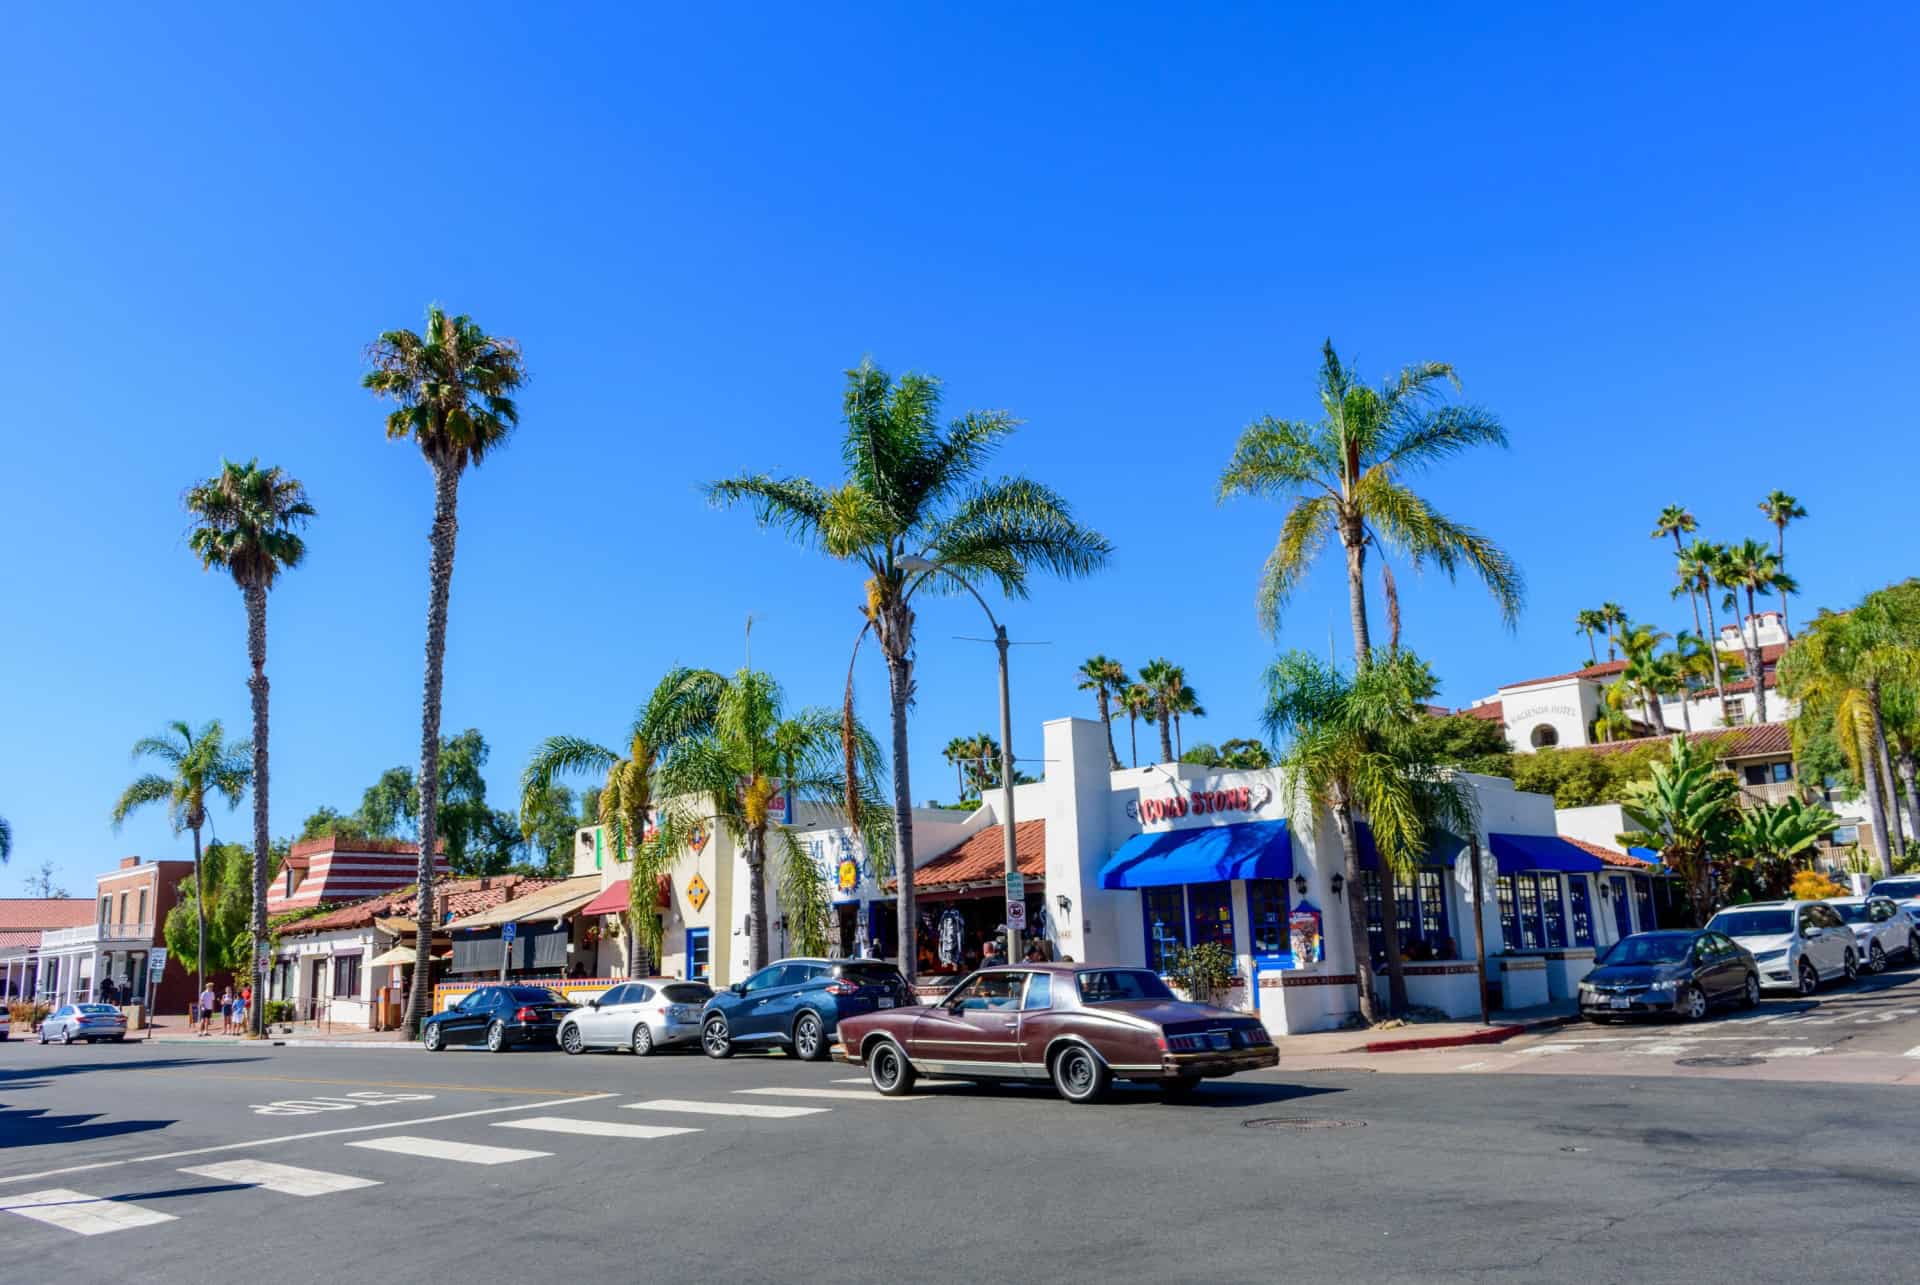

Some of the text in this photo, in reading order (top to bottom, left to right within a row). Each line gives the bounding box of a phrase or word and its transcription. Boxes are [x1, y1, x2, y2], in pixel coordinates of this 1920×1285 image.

[1142, 786, 1251, 823] COLD STONE
[248, 1091, 436, 1115] STOP
